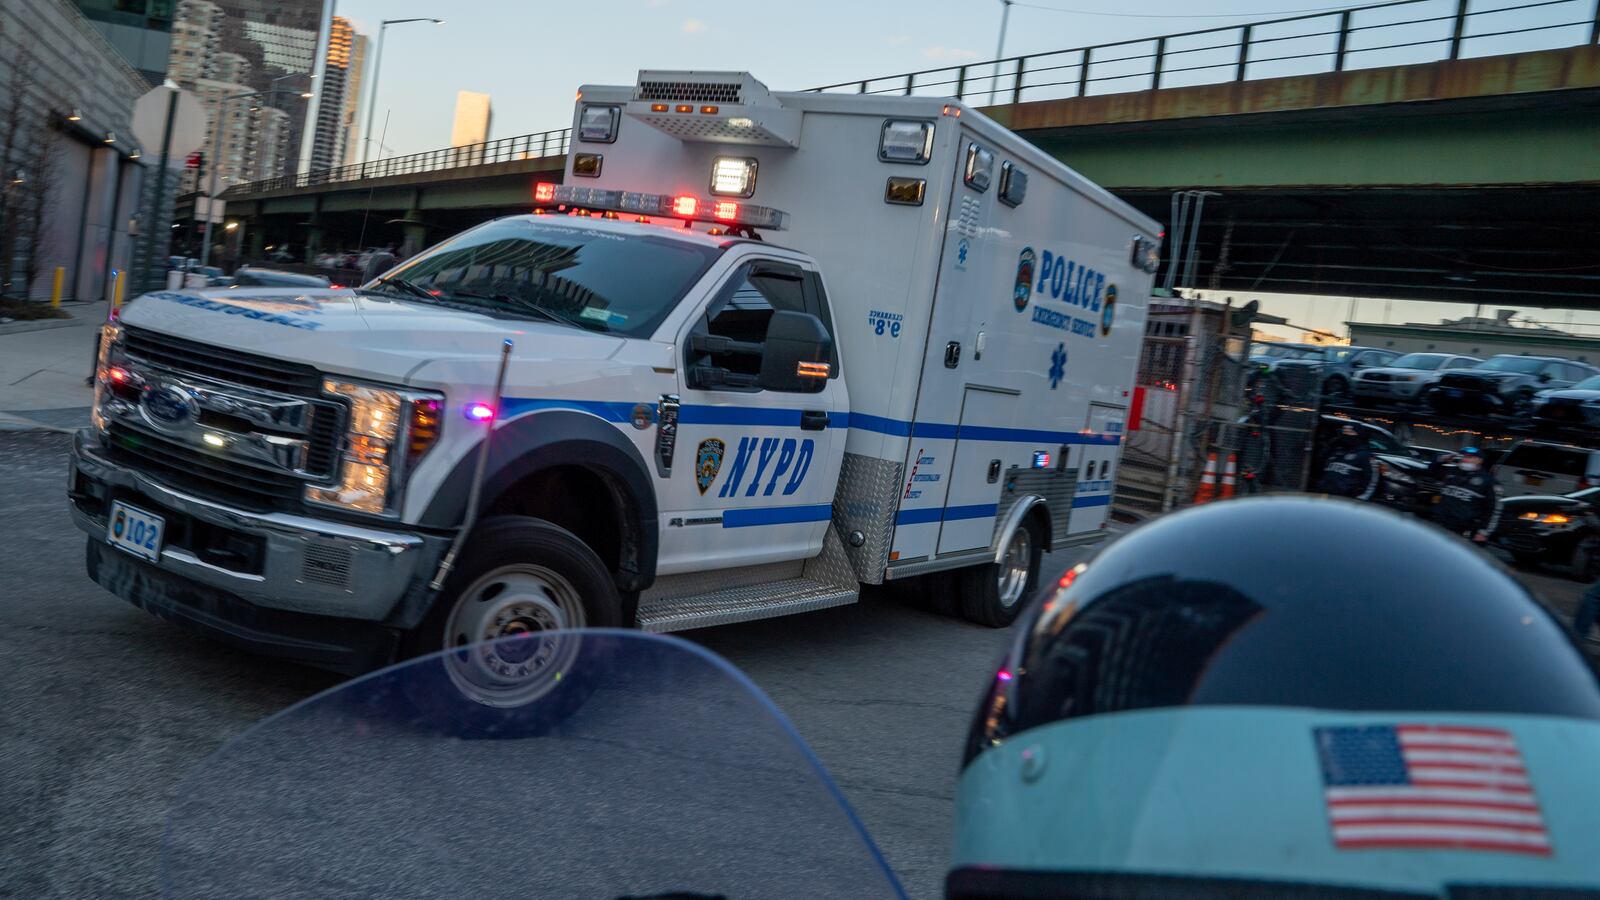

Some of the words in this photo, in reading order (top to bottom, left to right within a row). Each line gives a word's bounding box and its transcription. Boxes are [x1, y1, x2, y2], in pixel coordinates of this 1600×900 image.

[1037, 250, 1105, 312] POLICE
[718, 437, 815, 498] NYPD
[126, 516, 157, 550] 102
